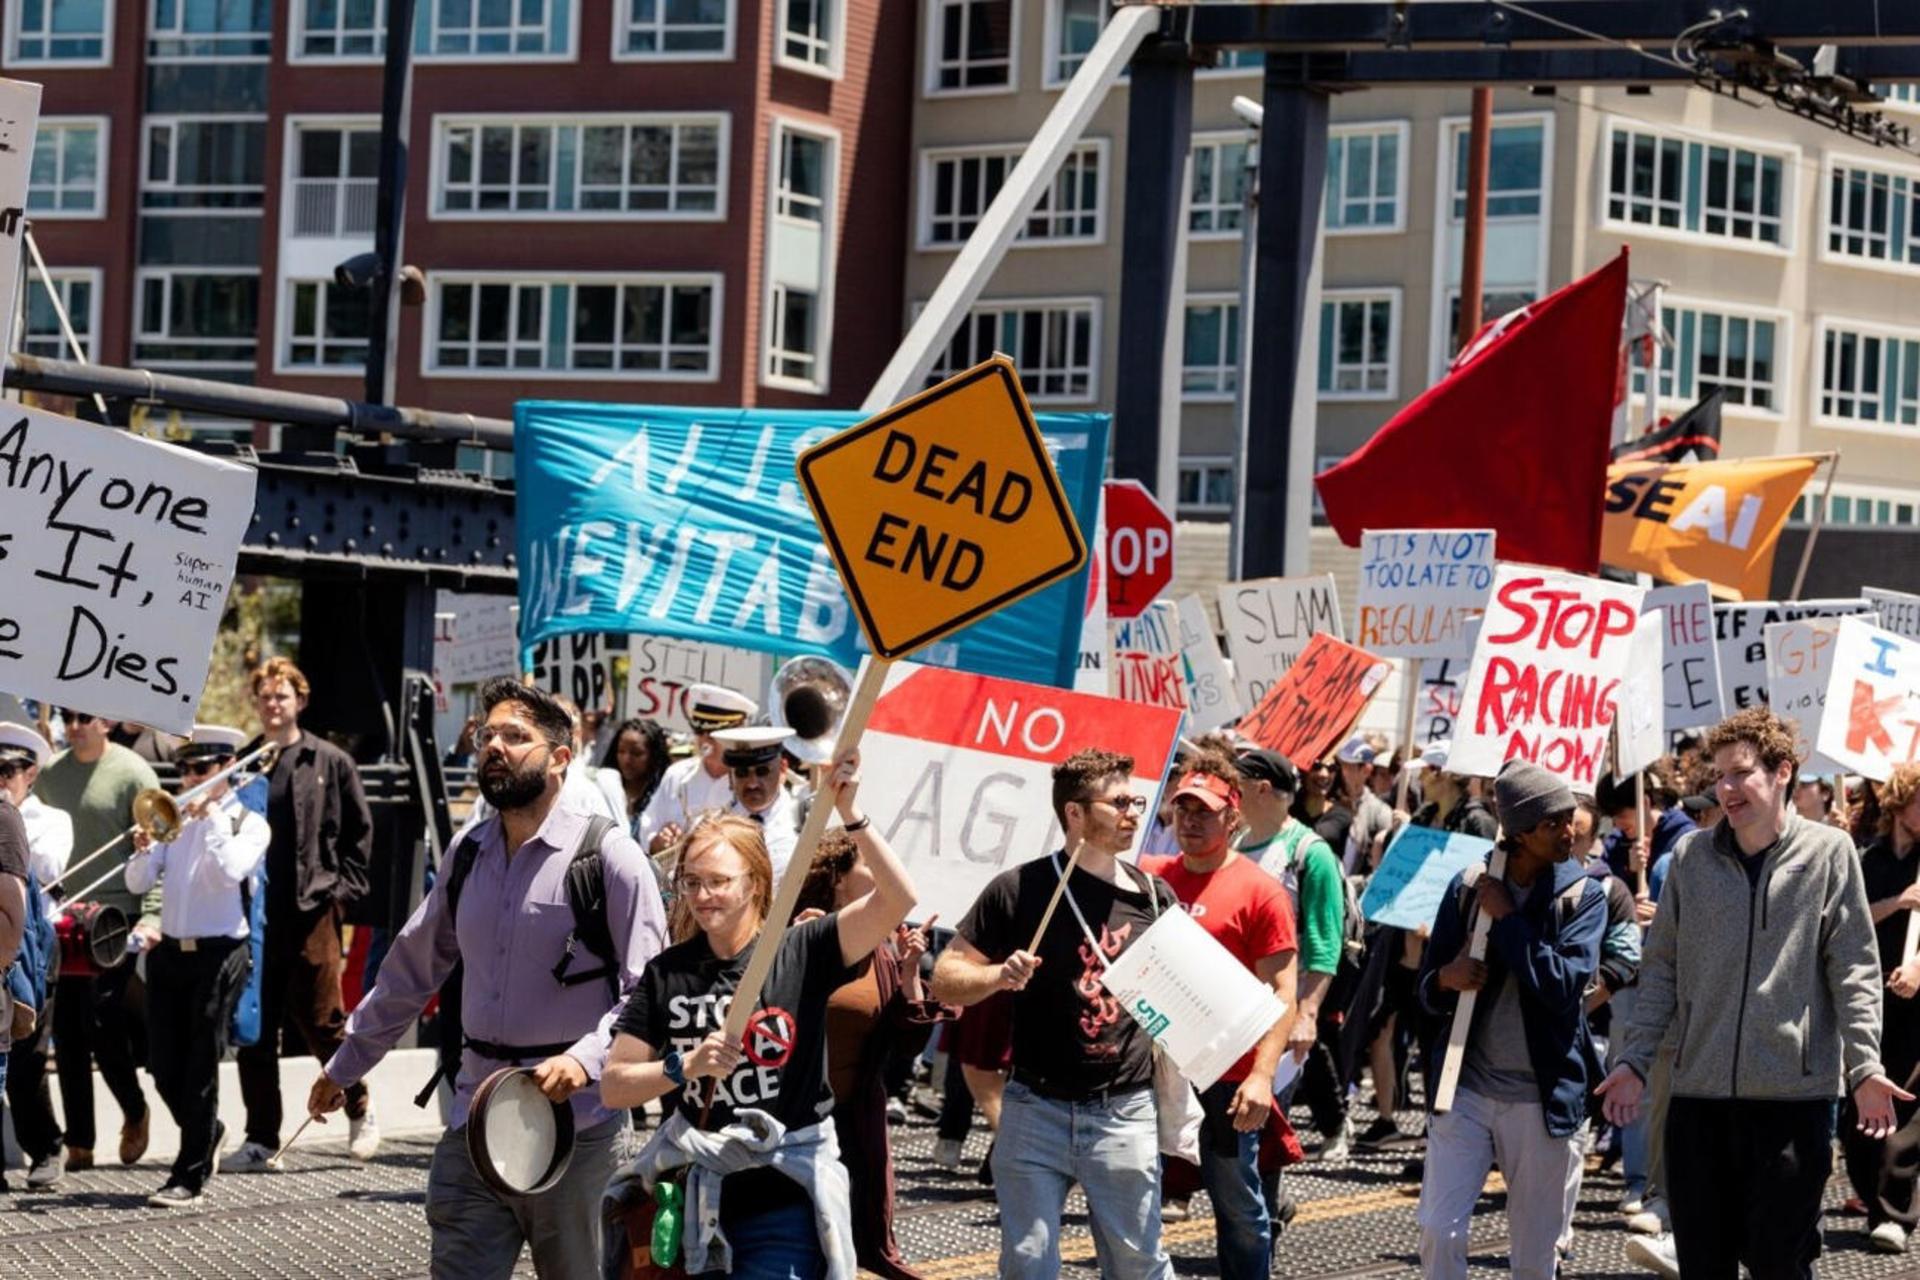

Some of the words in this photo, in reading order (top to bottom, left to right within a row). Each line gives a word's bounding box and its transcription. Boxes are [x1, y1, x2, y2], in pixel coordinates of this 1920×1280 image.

[0, 417, 208, 534] Anyone
[591, 421, 704, 494] AI
[873, 429, 1033, 525] DEAD
[35, 520, 154, 607] It,
[864, 511, 985, 592] END
[1109, 526, 1170, 576] OP
[1429, 532, 1490, 561] NOT
[179, 589, 212, 611] AI
[521, 520, 872, 653] INEVITAB
[1467, 564, 1491, 591] TO
[1237, 587, 1337, 644] SLAM
[1359, 603, 1486, 648] REGULAT
[1487, 577, 1637, 659] STOP
[1713, 609, 1748, 641] IF
[1759, 606, 1870, 638] ANY
[57, 604, 191, 703] Dies.
[1777, 627, 1840, 676] GP
[1863, 635, 1902, 678] I
[1114, 652, 1188, 709] UTURE
[1475, 655, 1621, 736] RACING
[975, 698, 1067, 753] NO
[1504, 729, 1604, 784] NOW
[884, 759, 1046, 867] AG
[668, 994, 736, 1029] STO
[682, 1065, 782, 1108] RACE
